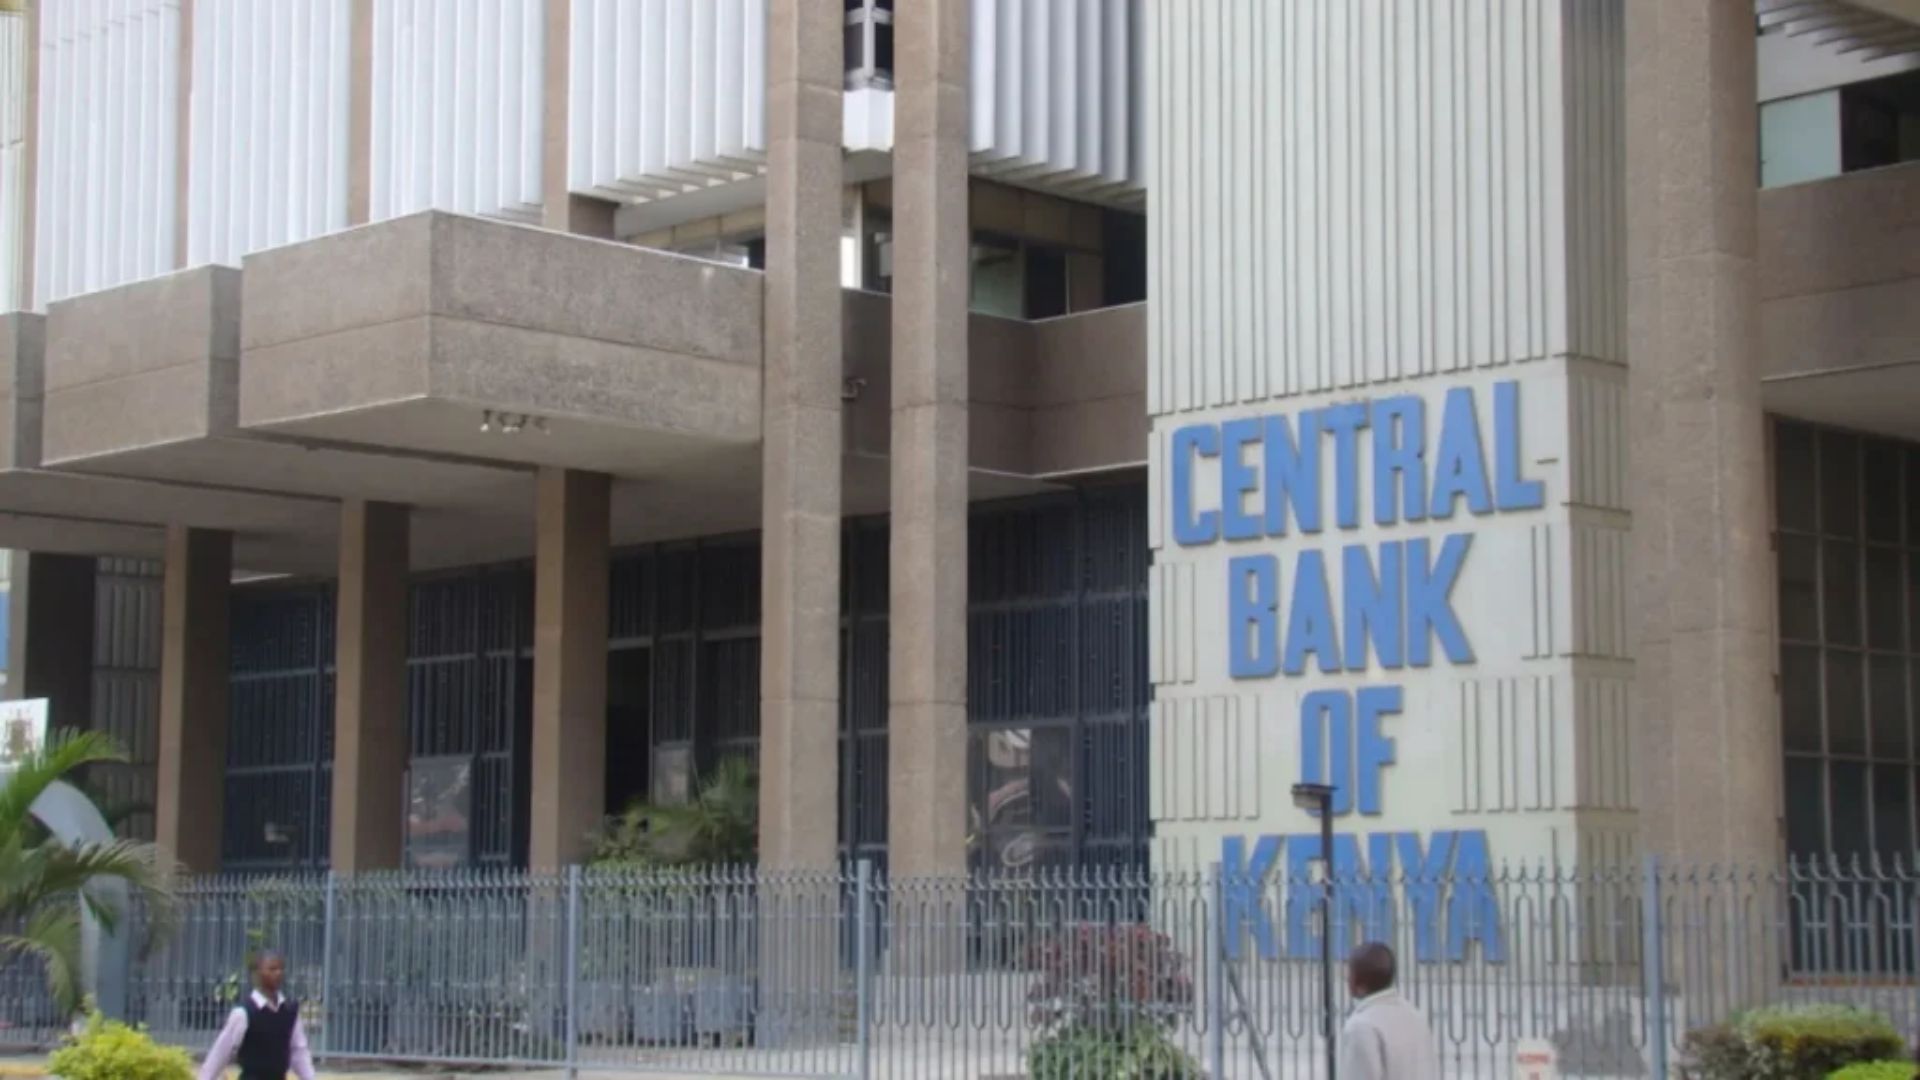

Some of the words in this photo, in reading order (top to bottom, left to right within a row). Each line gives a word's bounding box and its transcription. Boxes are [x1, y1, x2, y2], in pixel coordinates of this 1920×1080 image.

[1173, 380, 1545, 545] CENTRAL
[1229, 533, 1475, 679] BANK
[1301, 685, 1402, 816] OF
[1222, 830, 1505, 963] KENYA
